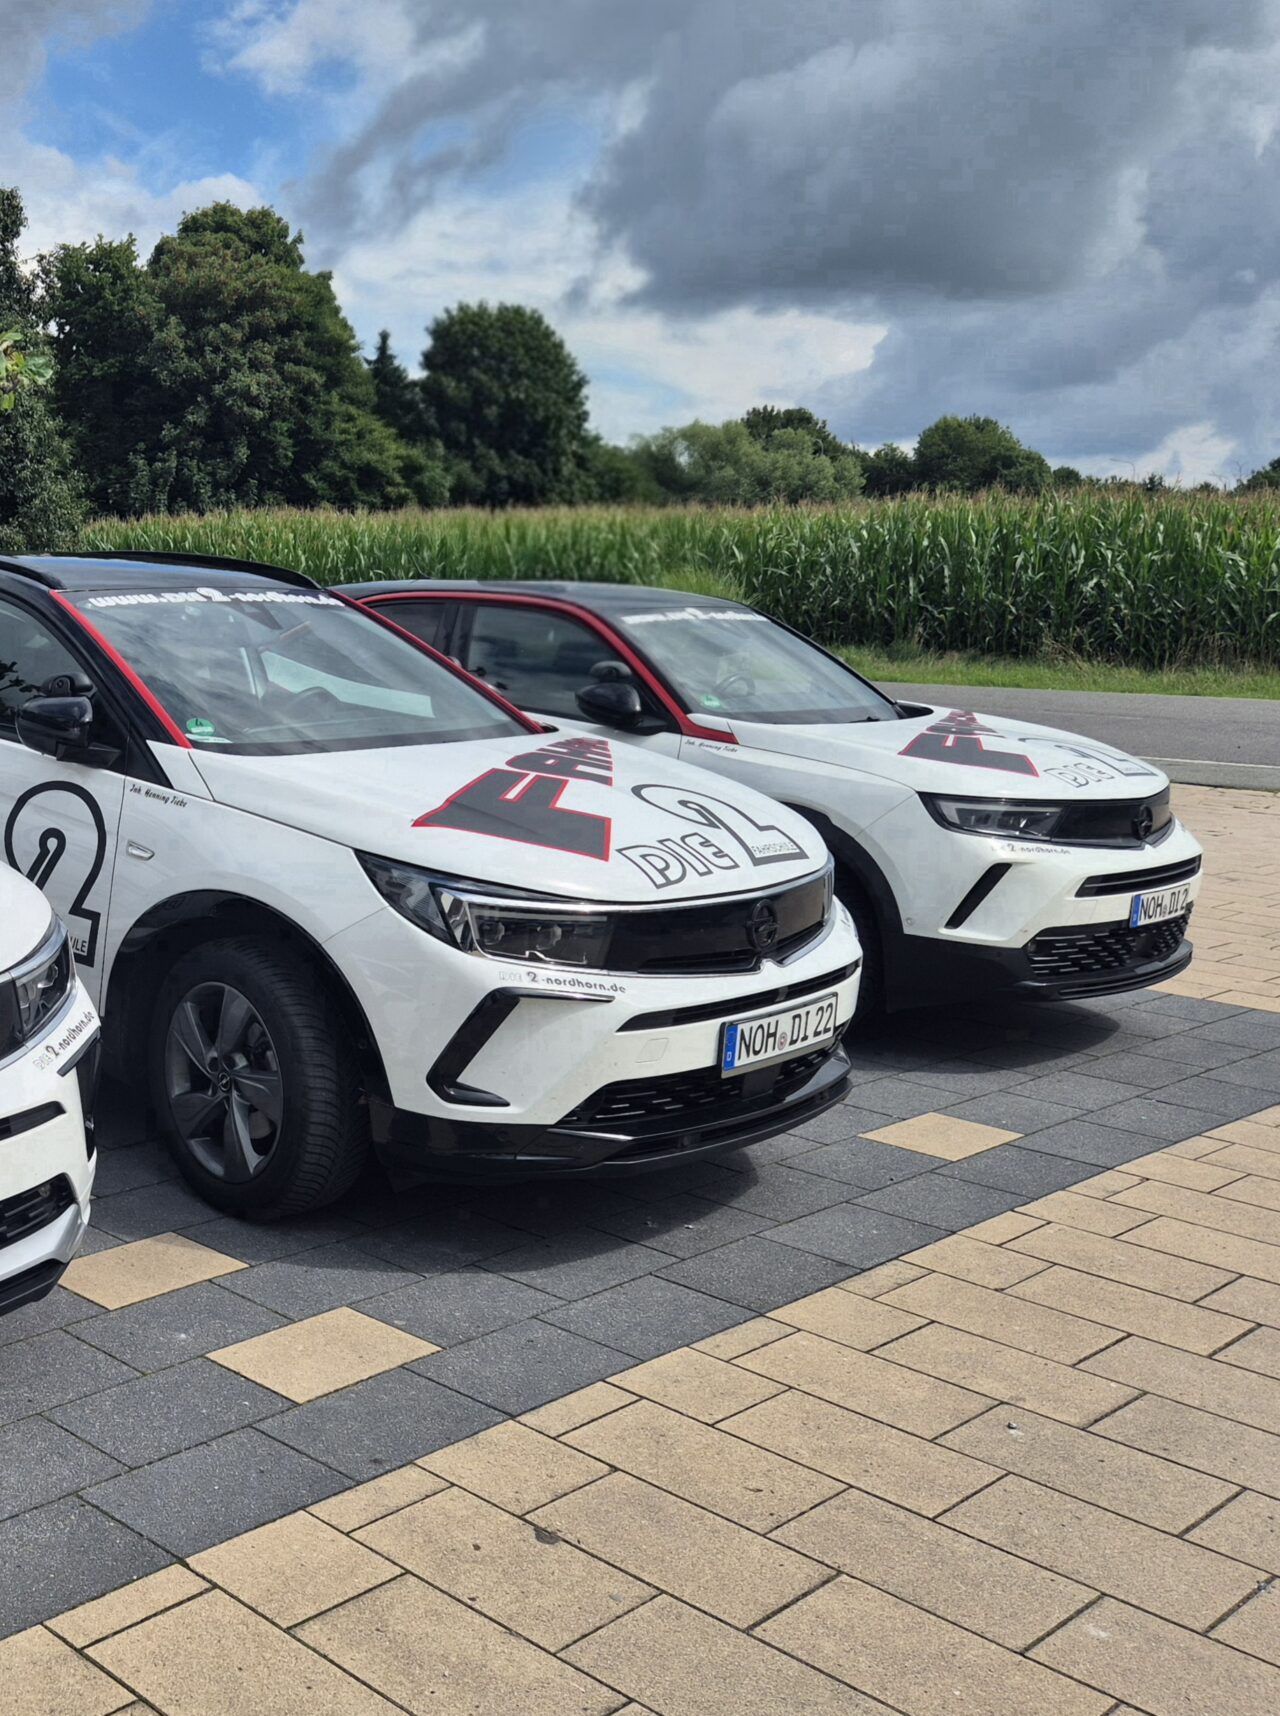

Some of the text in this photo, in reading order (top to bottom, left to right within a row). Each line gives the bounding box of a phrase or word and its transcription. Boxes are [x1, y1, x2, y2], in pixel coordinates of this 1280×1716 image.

[615, 783, 810, 890] DIE 2
[1139, 894, 1165, 921] NOH
[738, 1019, 779, 1061] NOH
[788, 1009, 811, 1047] DI
[813, 1002, 834, 1039] 22
